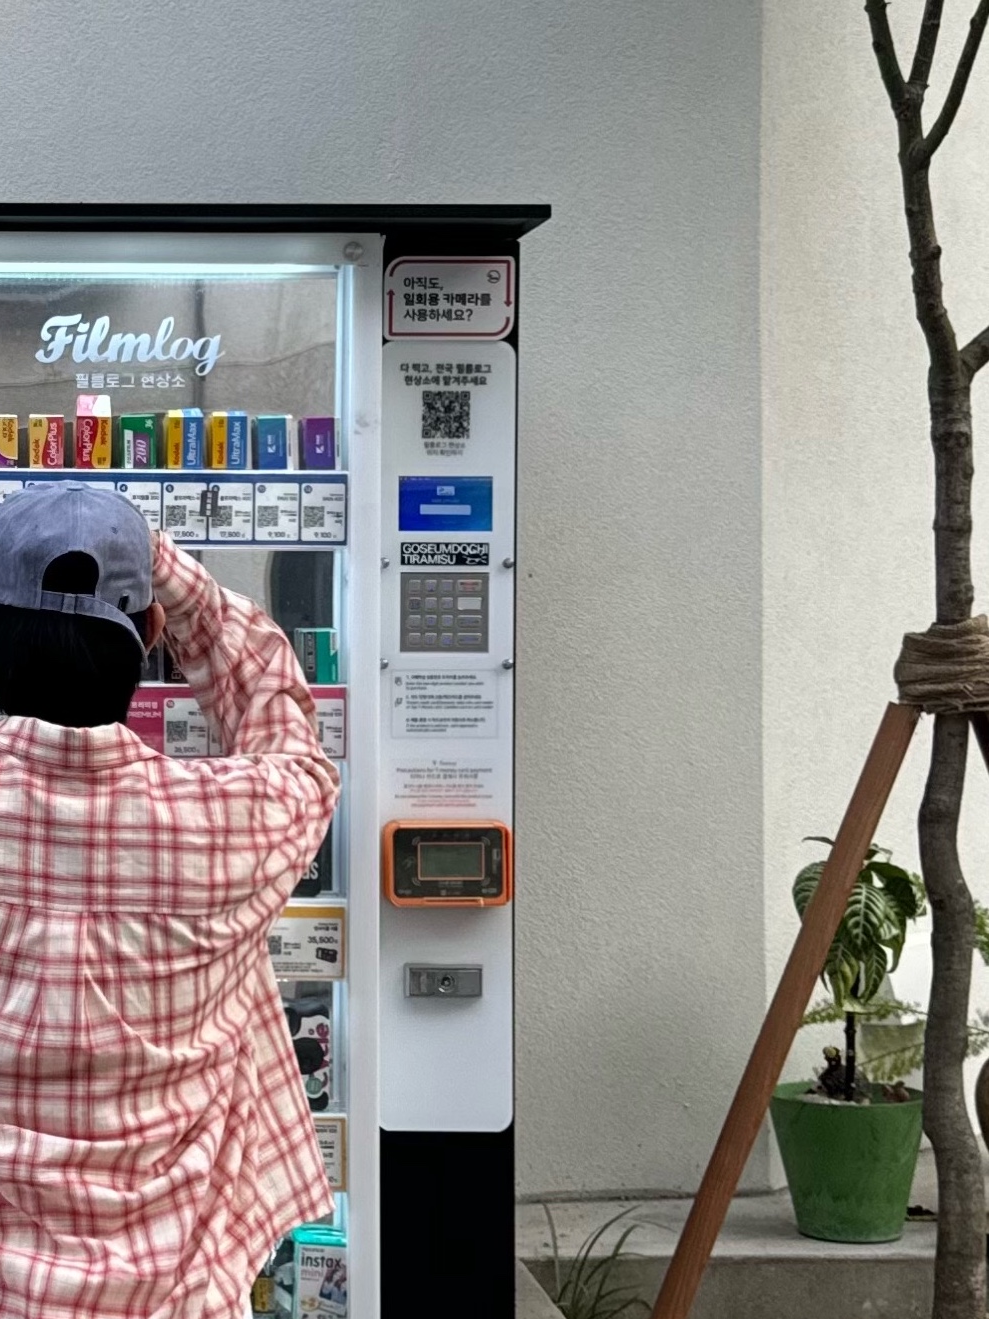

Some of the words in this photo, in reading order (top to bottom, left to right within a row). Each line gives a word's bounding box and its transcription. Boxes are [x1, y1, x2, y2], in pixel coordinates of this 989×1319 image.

[403, 276, 444, 291] 아직도,
[403, 292, 440, 307] 일회용
[443, 292, 492, 307] 카메라를
[403, 308, 474, 322] 사용하세요?
[35, 313, 226, 377] Filmlog
[75, 372, 136, 389] 필름로그
[47, 422, 58, 466] ColorPlus
[82, 418, 93, 462] ColorPlus
[100, 419, 109, 446] Kodak
[187, 422, 197, 466] UltraMax
[230, 421, 242, 465] UltraMax
[32, 438, 41, 465] Kodak
[135, 439, 148, 464] 200
[402, 553, 457, 565] TIRAMISU
[300, 1251, 342, 1269] instax
